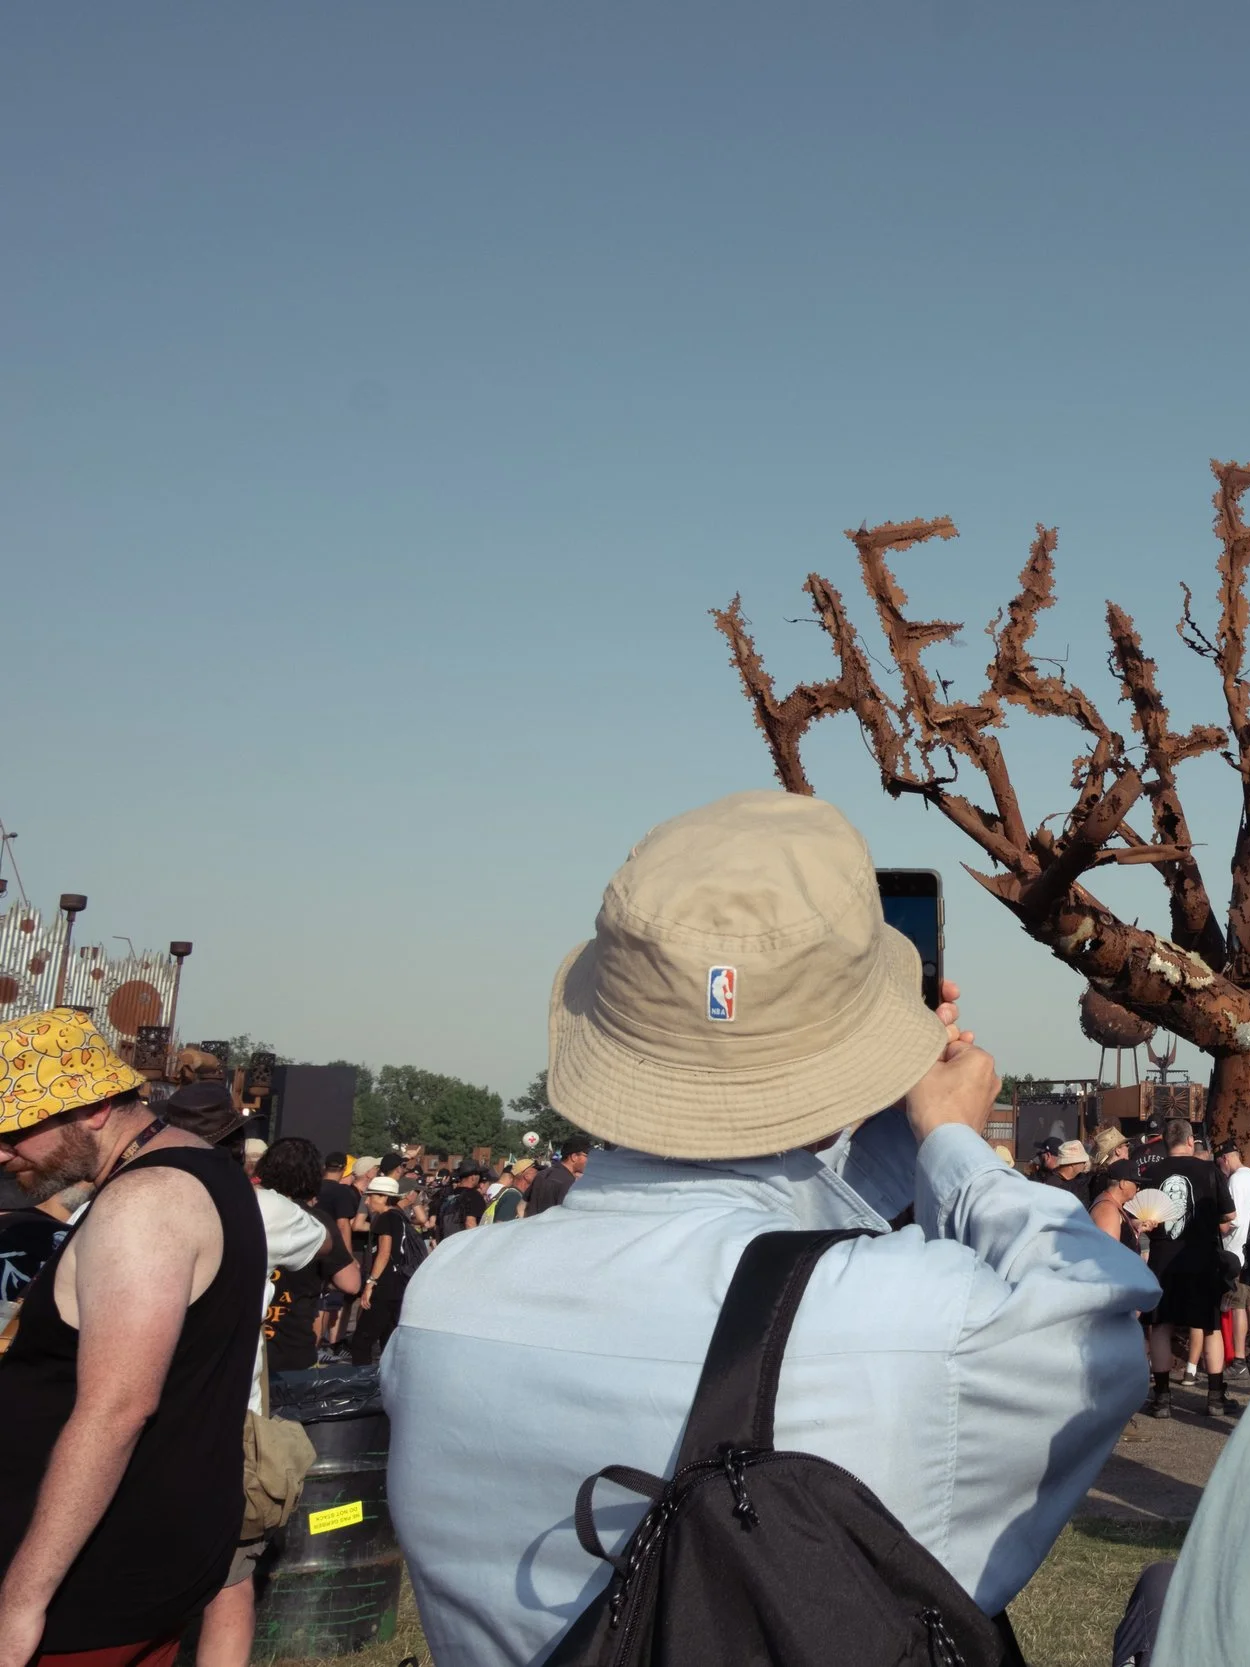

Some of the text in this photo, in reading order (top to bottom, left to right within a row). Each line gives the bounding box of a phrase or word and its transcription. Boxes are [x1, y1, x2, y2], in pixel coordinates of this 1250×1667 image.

[711, 1008, 726, 1016] NBA
[1135, 1154, 1165, 1167] ELLFES
[315, 1513, 335, 1521] STACK
[337, 1509, 348, 1517] NOT
